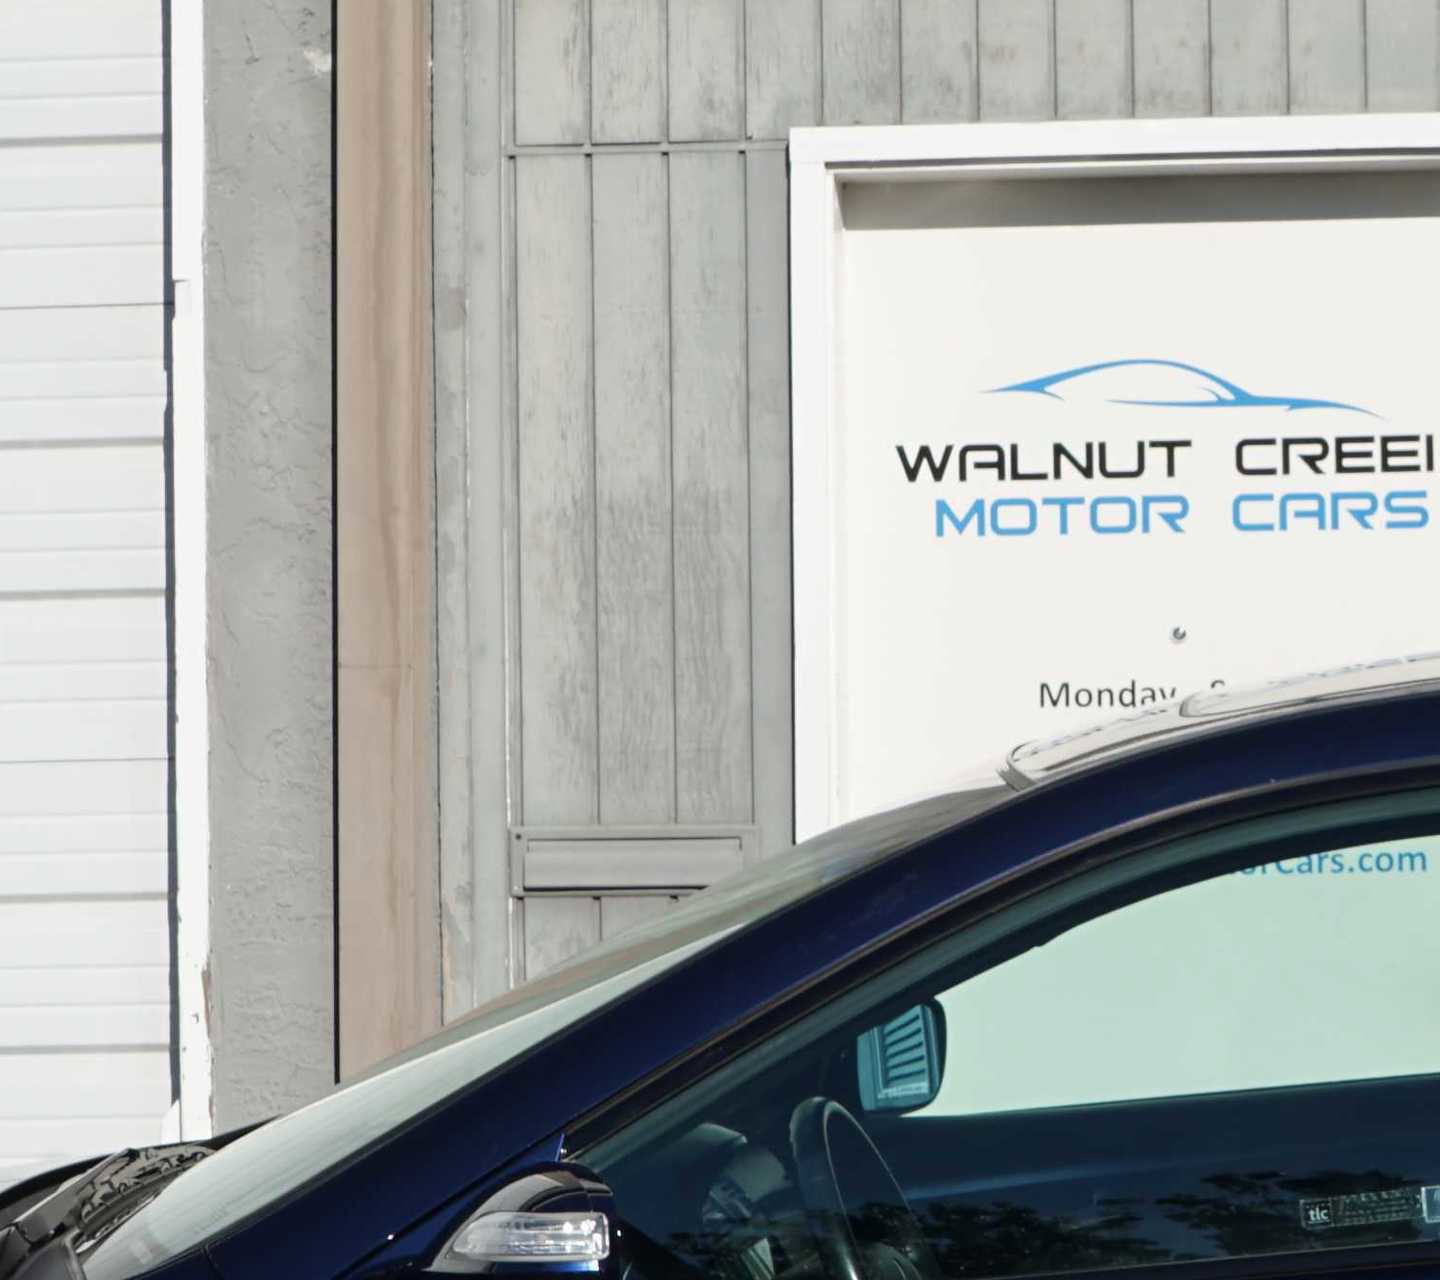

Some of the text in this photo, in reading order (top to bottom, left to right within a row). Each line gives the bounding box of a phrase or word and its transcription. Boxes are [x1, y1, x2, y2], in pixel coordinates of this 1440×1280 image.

[896, 439, 1192, 483] WALNUT
[935, 489, 1430, 538] MOTOR CARS
